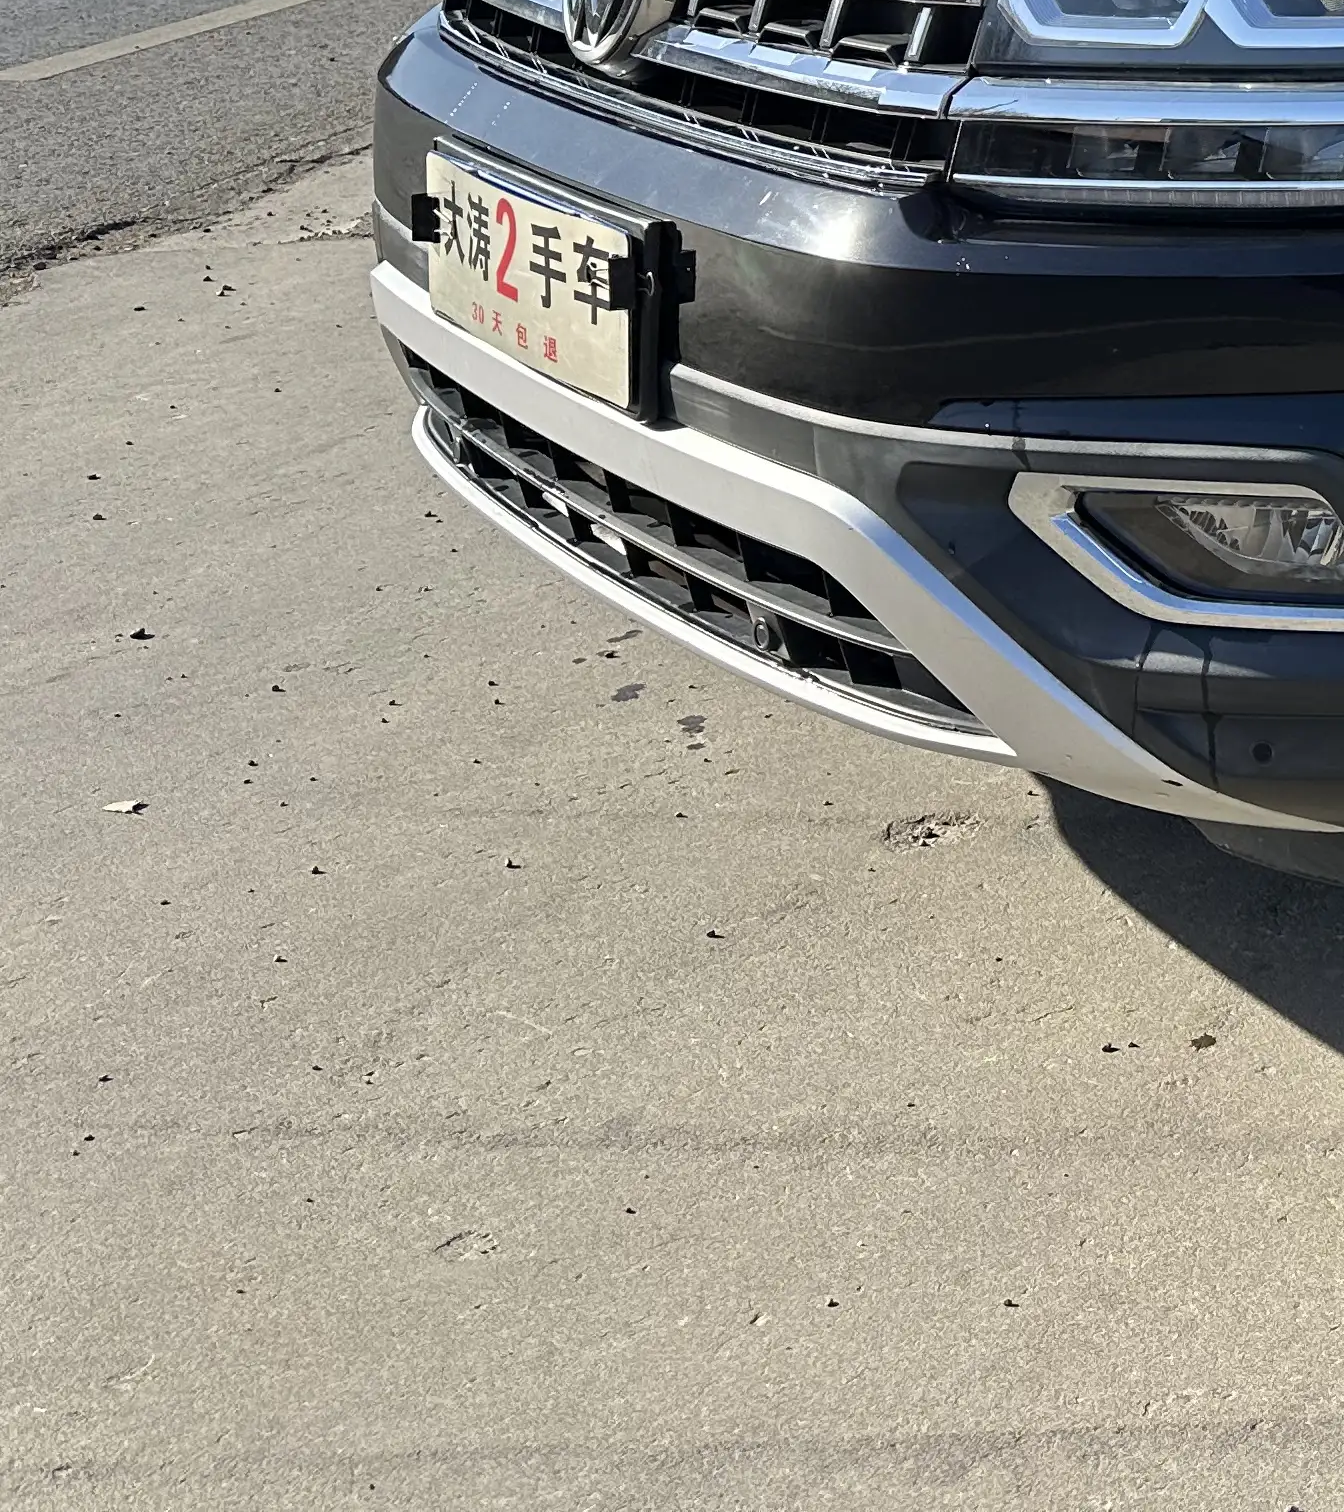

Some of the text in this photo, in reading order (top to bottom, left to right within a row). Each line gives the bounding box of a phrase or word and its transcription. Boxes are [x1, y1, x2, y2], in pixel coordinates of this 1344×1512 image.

[443, 180, 612, 326] 大涛2手车
[471, 300, 559, 364] 30天包退
